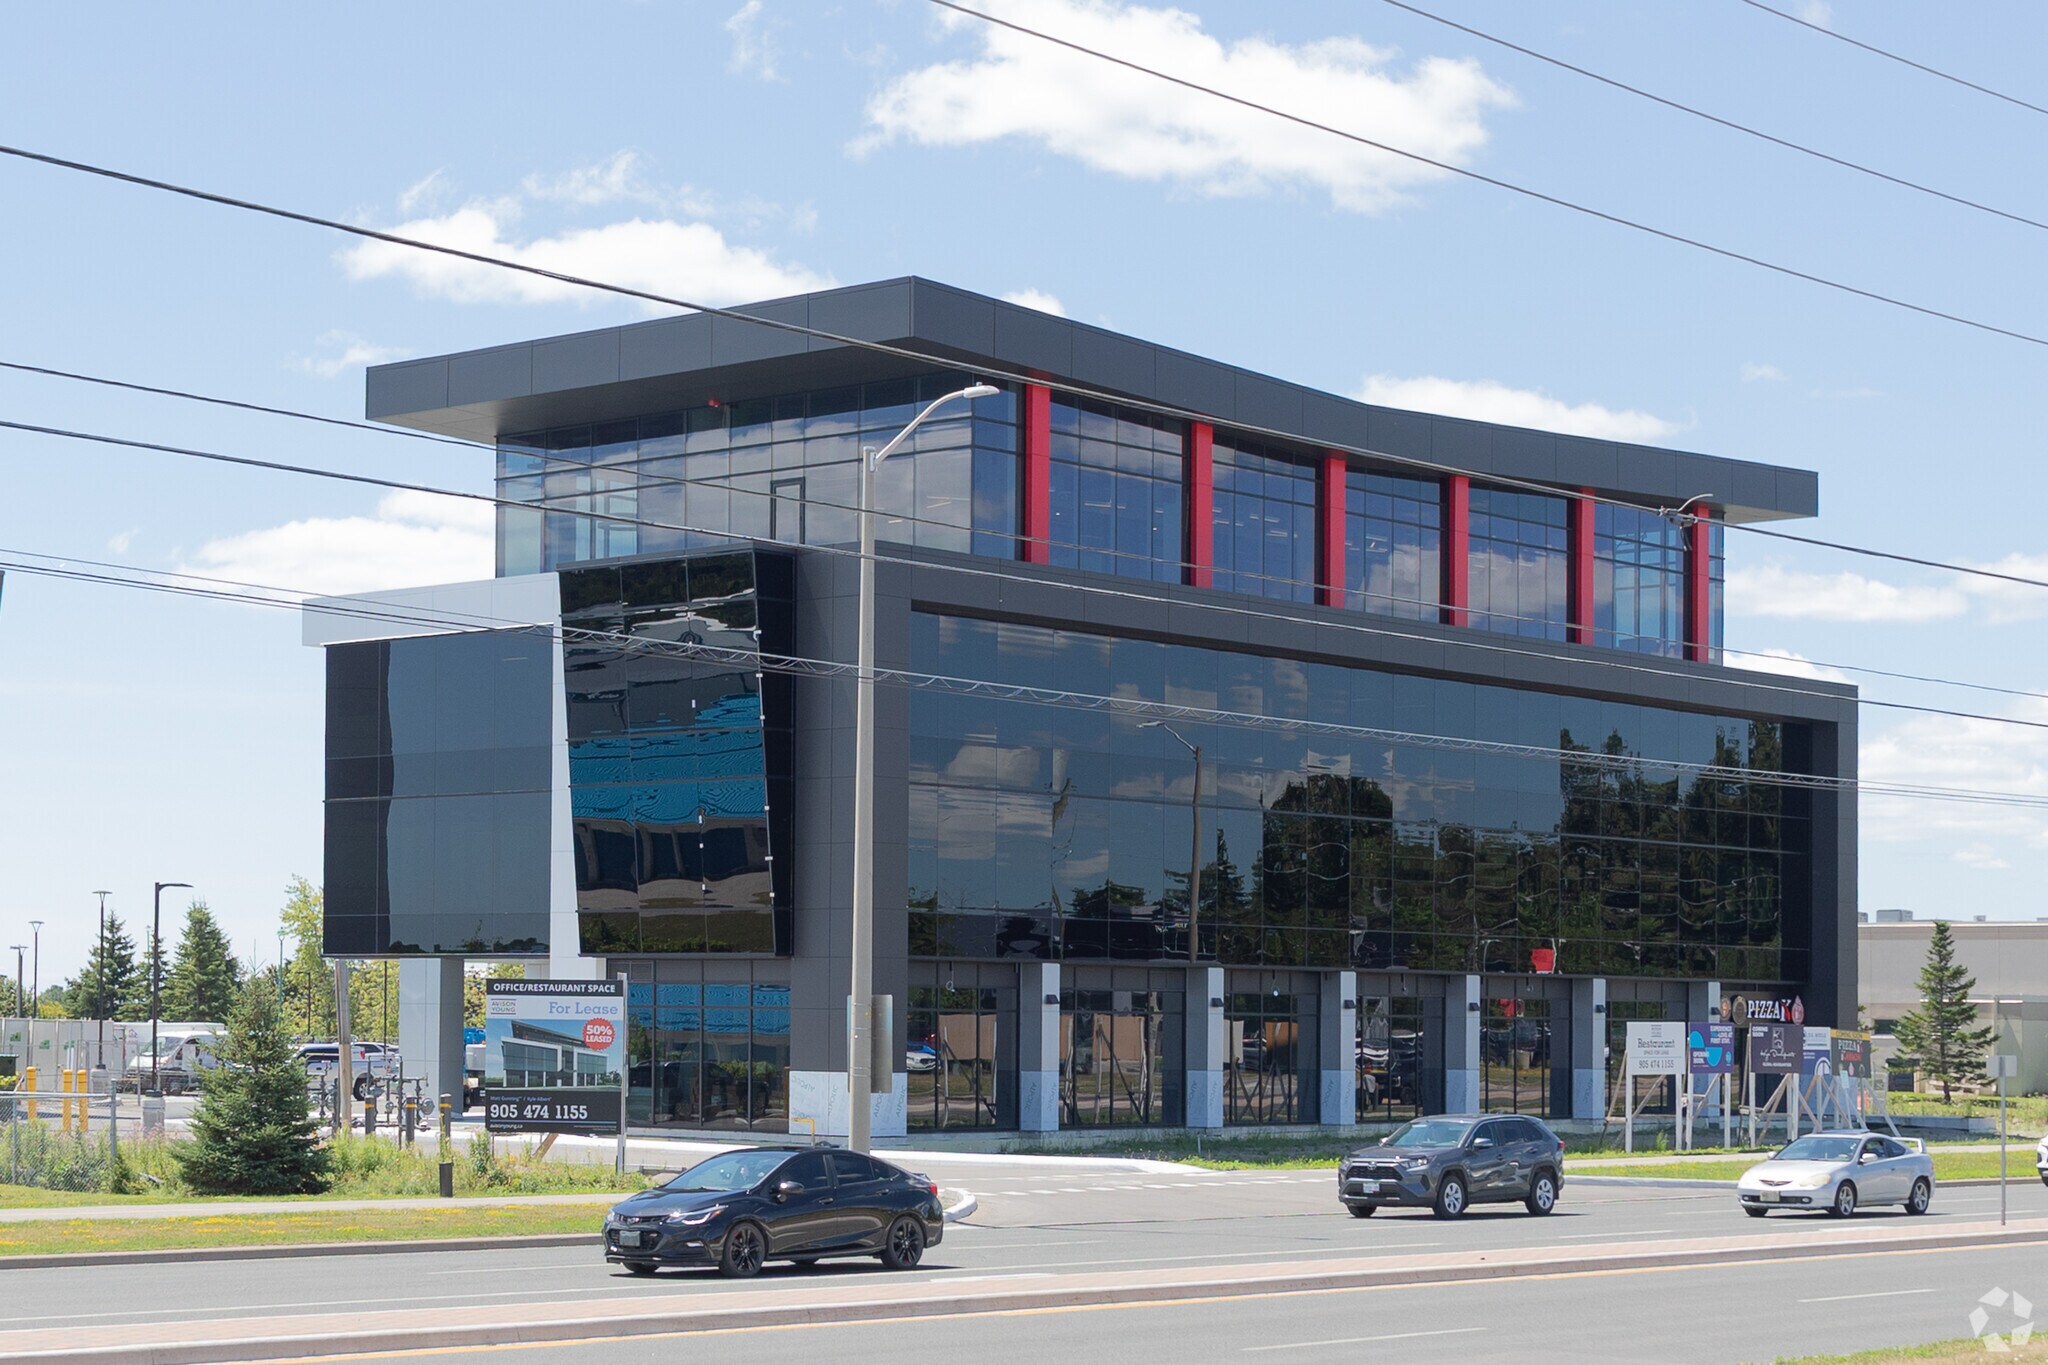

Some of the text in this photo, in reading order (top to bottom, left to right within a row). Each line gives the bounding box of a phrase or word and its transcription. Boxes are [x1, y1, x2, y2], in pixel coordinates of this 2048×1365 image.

[493, 983, 615, 993] OFFICE/RESTAURANT SPACE
[549, 1002, 618, 1015] For Lease
[586, 1025, 612, 1035] 50%
[585, 1035, 612, 1043] LEASED
[1650, 1060, 1660, 1068] 474
[1661, 1060, 1675, 1068] 1155
[490, 1104, 588, 1119] 905 474 1155
